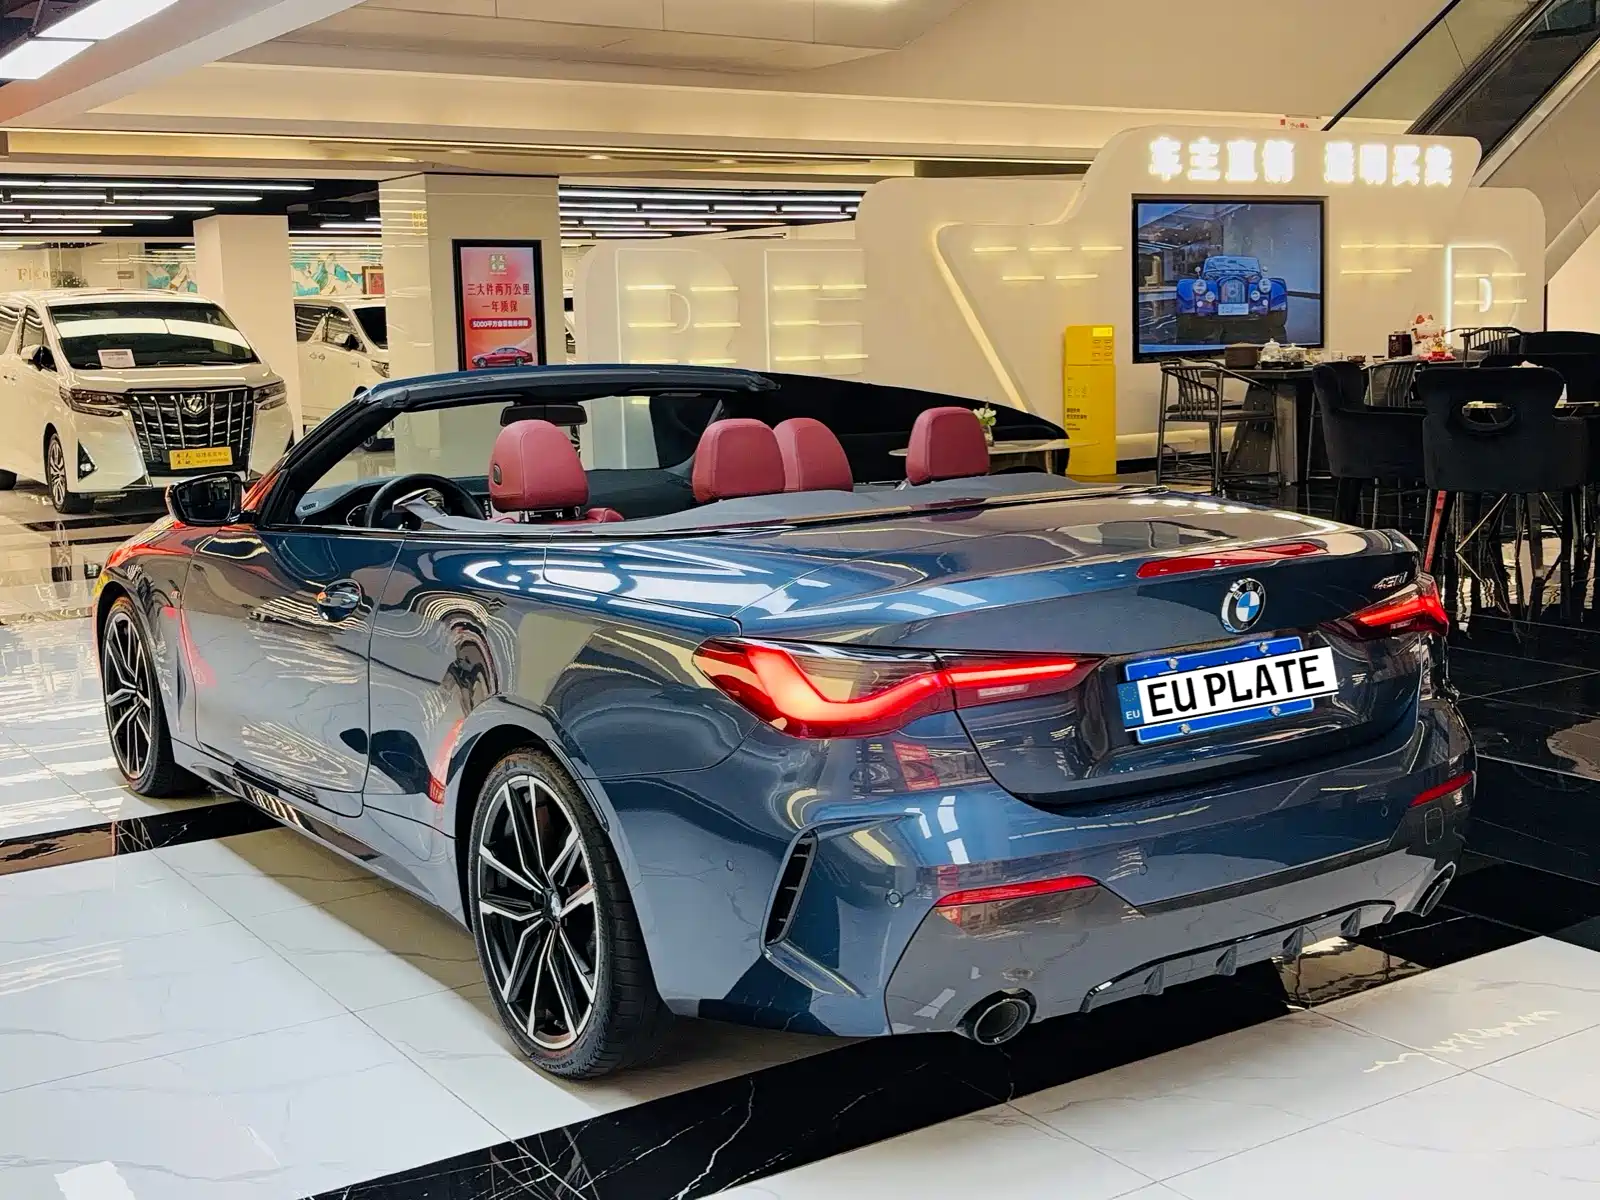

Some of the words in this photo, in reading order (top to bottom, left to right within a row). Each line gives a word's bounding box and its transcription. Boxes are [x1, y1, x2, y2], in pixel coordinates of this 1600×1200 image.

[467, 282, 532, 296] 三大件两万公里
[481, 300, 519, 313] 一年质保
[1125, 709, 1141, 721] EU
[1146, 677, 1196, 718] EU
[1203, 654, 1326, 707] PLATE
